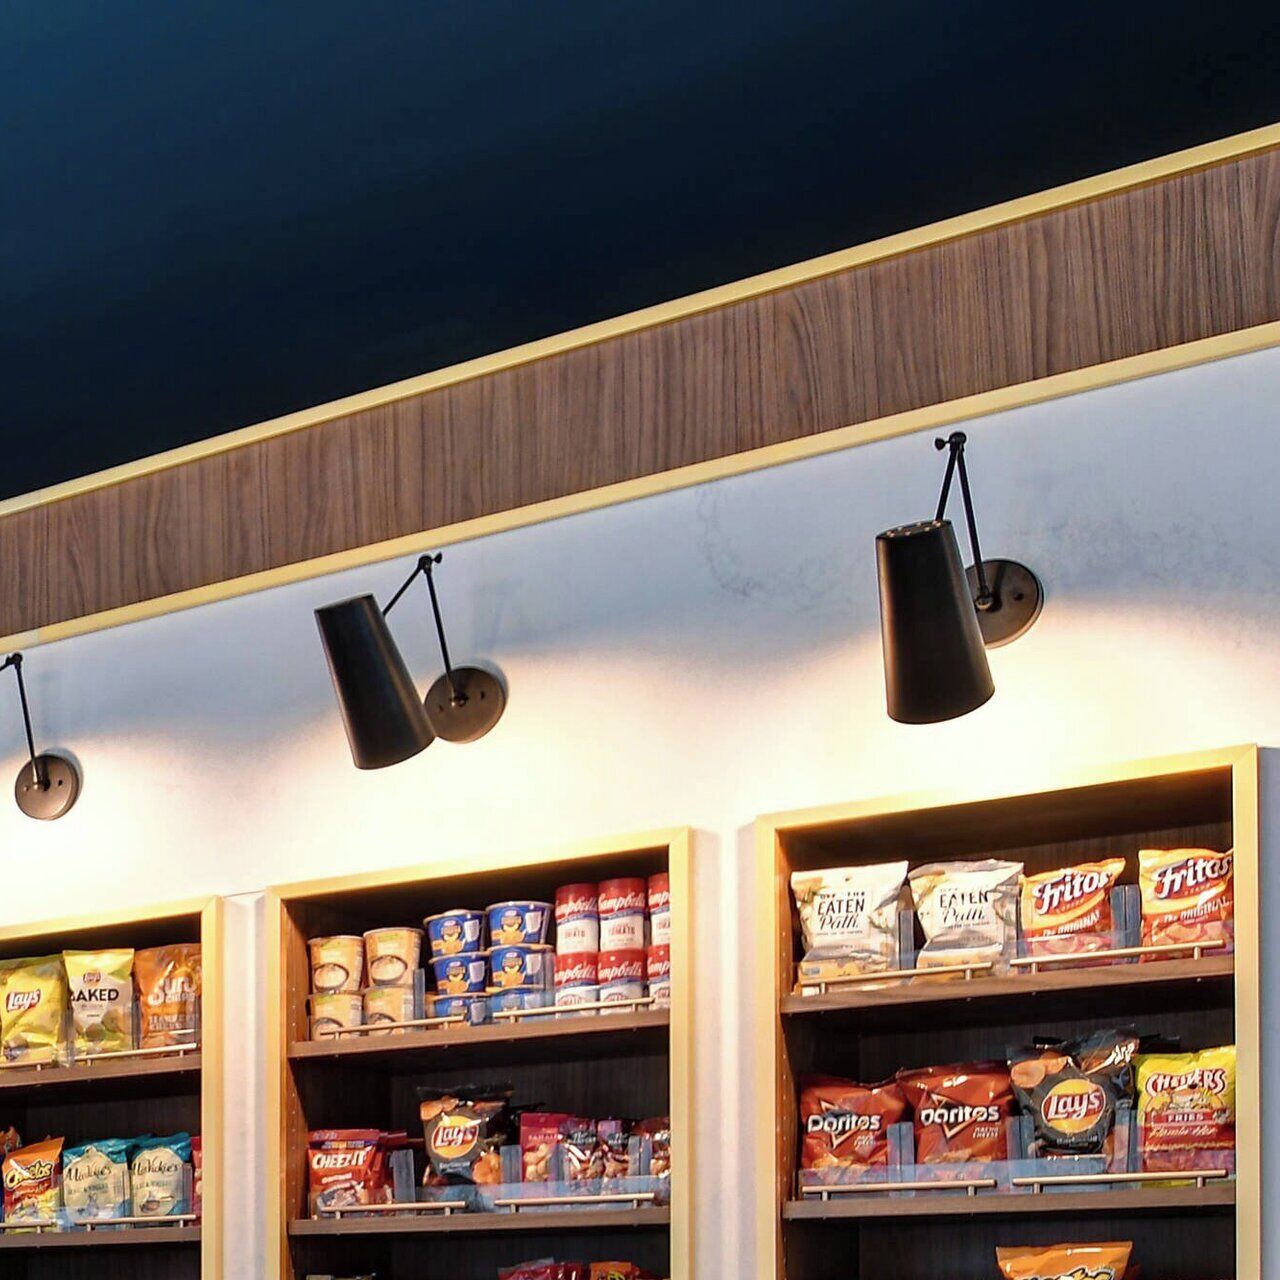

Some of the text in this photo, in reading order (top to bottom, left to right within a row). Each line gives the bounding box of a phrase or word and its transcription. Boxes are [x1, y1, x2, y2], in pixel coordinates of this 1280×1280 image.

[1152, 856, 1233, 899] Fritos
[939, 890, 990, 909] EATEN
[1032, 868, 1114, 915] Fritos
[817, 896, 865, 916] EATEN
[807, 1114, 882, 1134] Doritos
[920, 1104, 1000, 1126] Doritos
